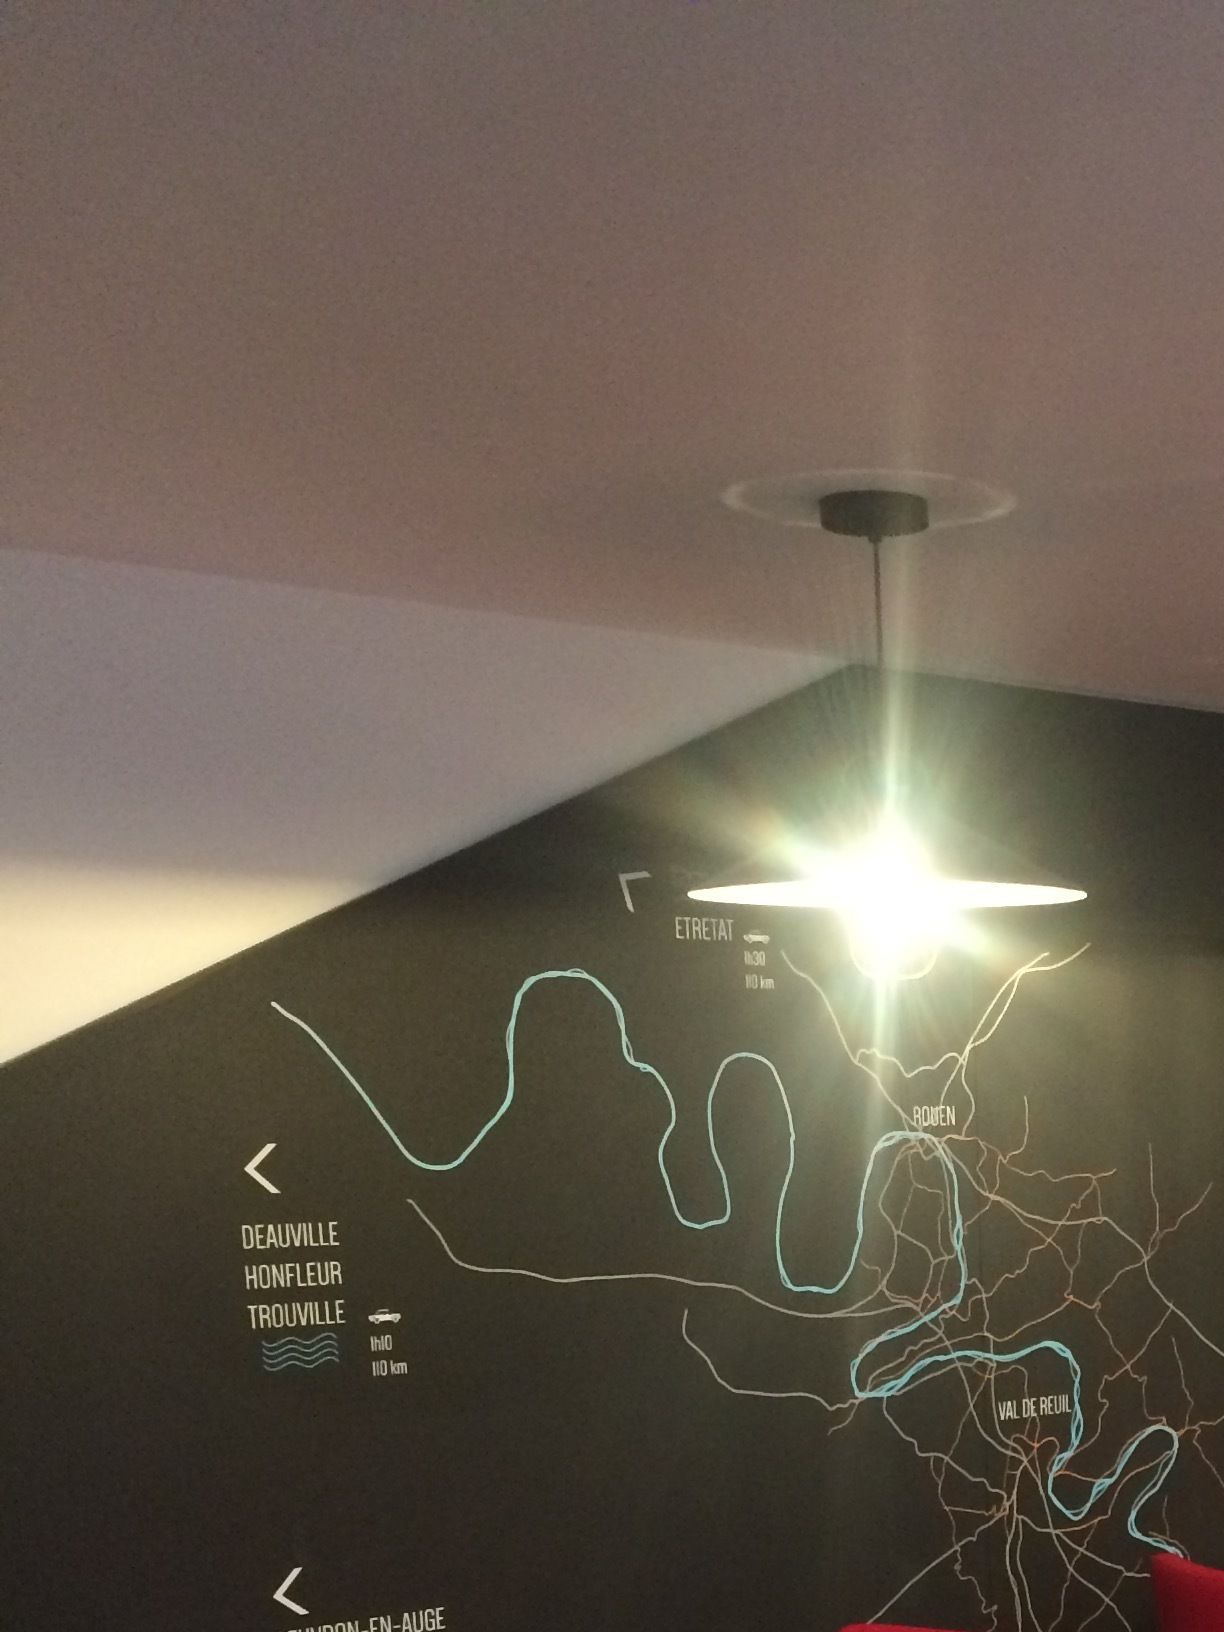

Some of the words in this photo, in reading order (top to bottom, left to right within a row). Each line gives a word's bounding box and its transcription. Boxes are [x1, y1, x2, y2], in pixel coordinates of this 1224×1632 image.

[675, 916, 734, 941] ETRETAT
[760, 975, 775, 990] km
[913, 1105, 956, 1127] ROUEN
[241, 1221, 340, 1249] DEAUVILLE
[244, 1261, 343, 1290] HONFLEUR
[247, 1300, 346, 1330] TROUVILLE
[390, 1360, 408, 1375] km
[998, 1400, 1020, 1421] VAL
[1022, 1398, 1037, 1417] DE
[1039, 1394, 1072, 1416] REUIL
